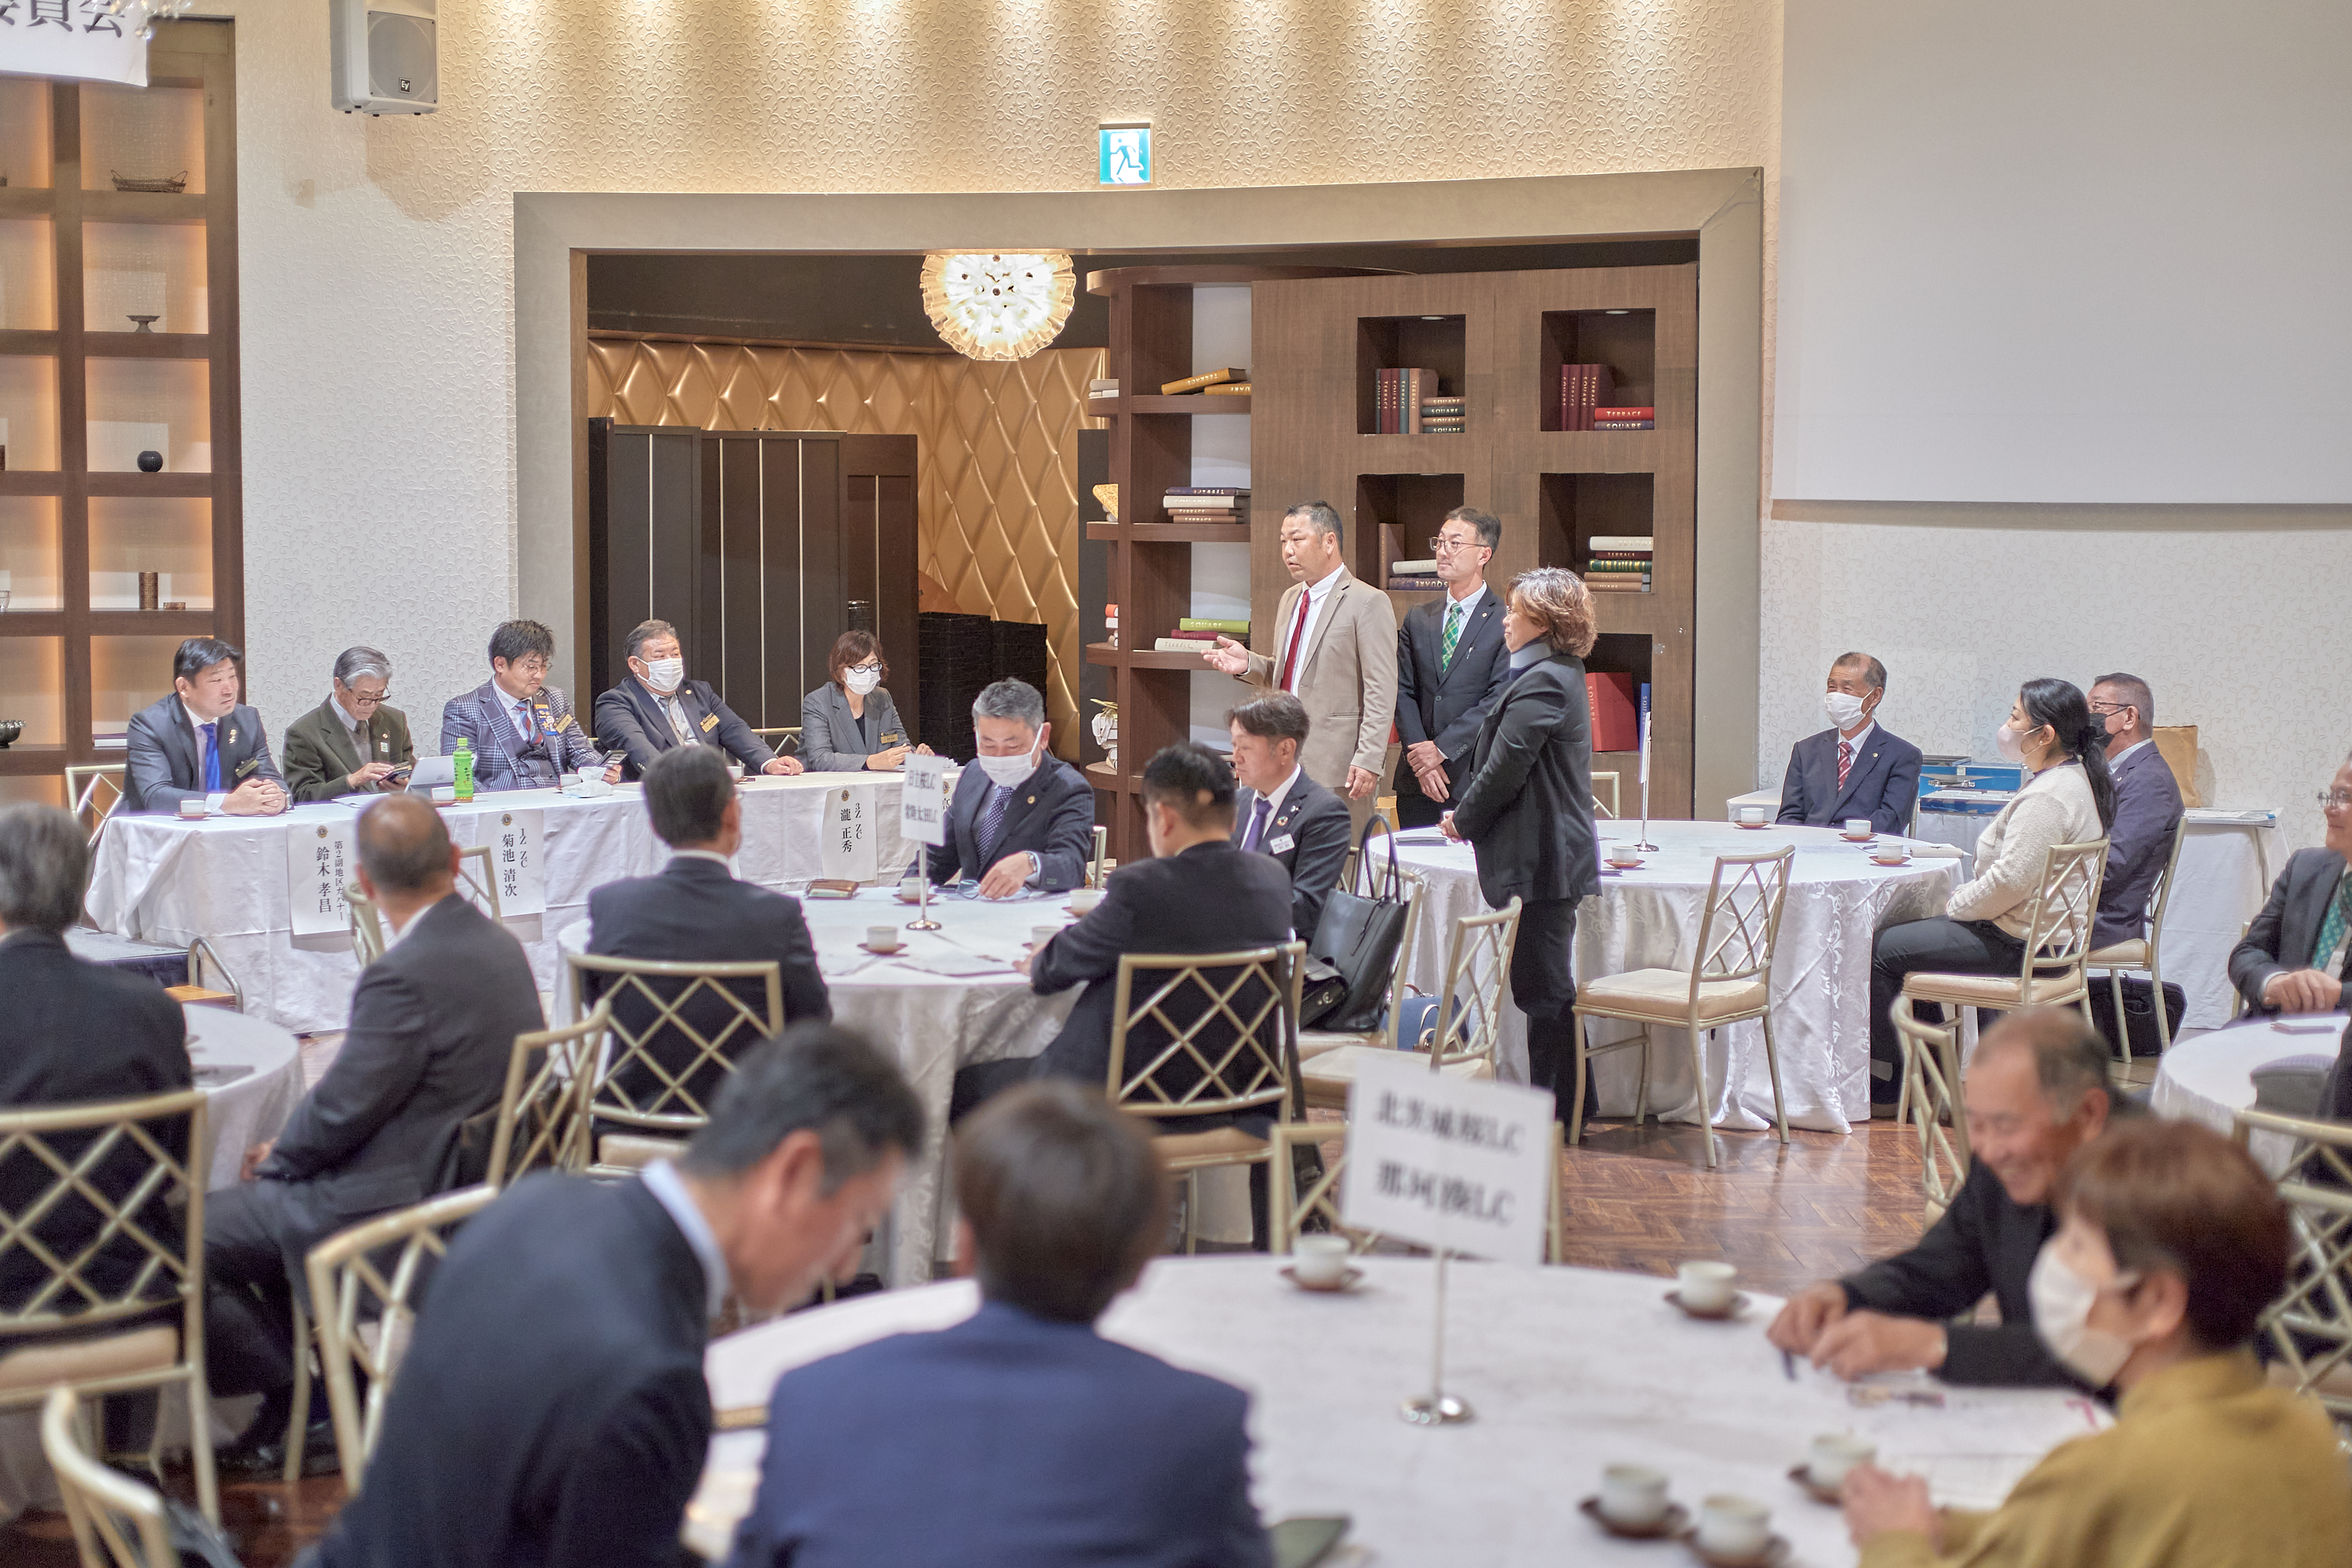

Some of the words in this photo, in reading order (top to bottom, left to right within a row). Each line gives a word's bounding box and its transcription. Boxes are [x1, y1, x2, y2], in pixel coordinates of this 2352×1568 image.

[0, 0, 125, 38] 員会
[1587, 685, 1595, 720] SQUARE
[855, 802, 862, 818] 3Z
[519, 828, 527, 845] 1Z
[855, 823, 862, 840] ZC
[316, 846, 330, 877] 鈴木
[502, 833, 515, 862] 菊池
[520, 851, 528, 868] ZC
[318, 882, 332, 913] 孝昌
[503, 868, 517, 898] 清次
